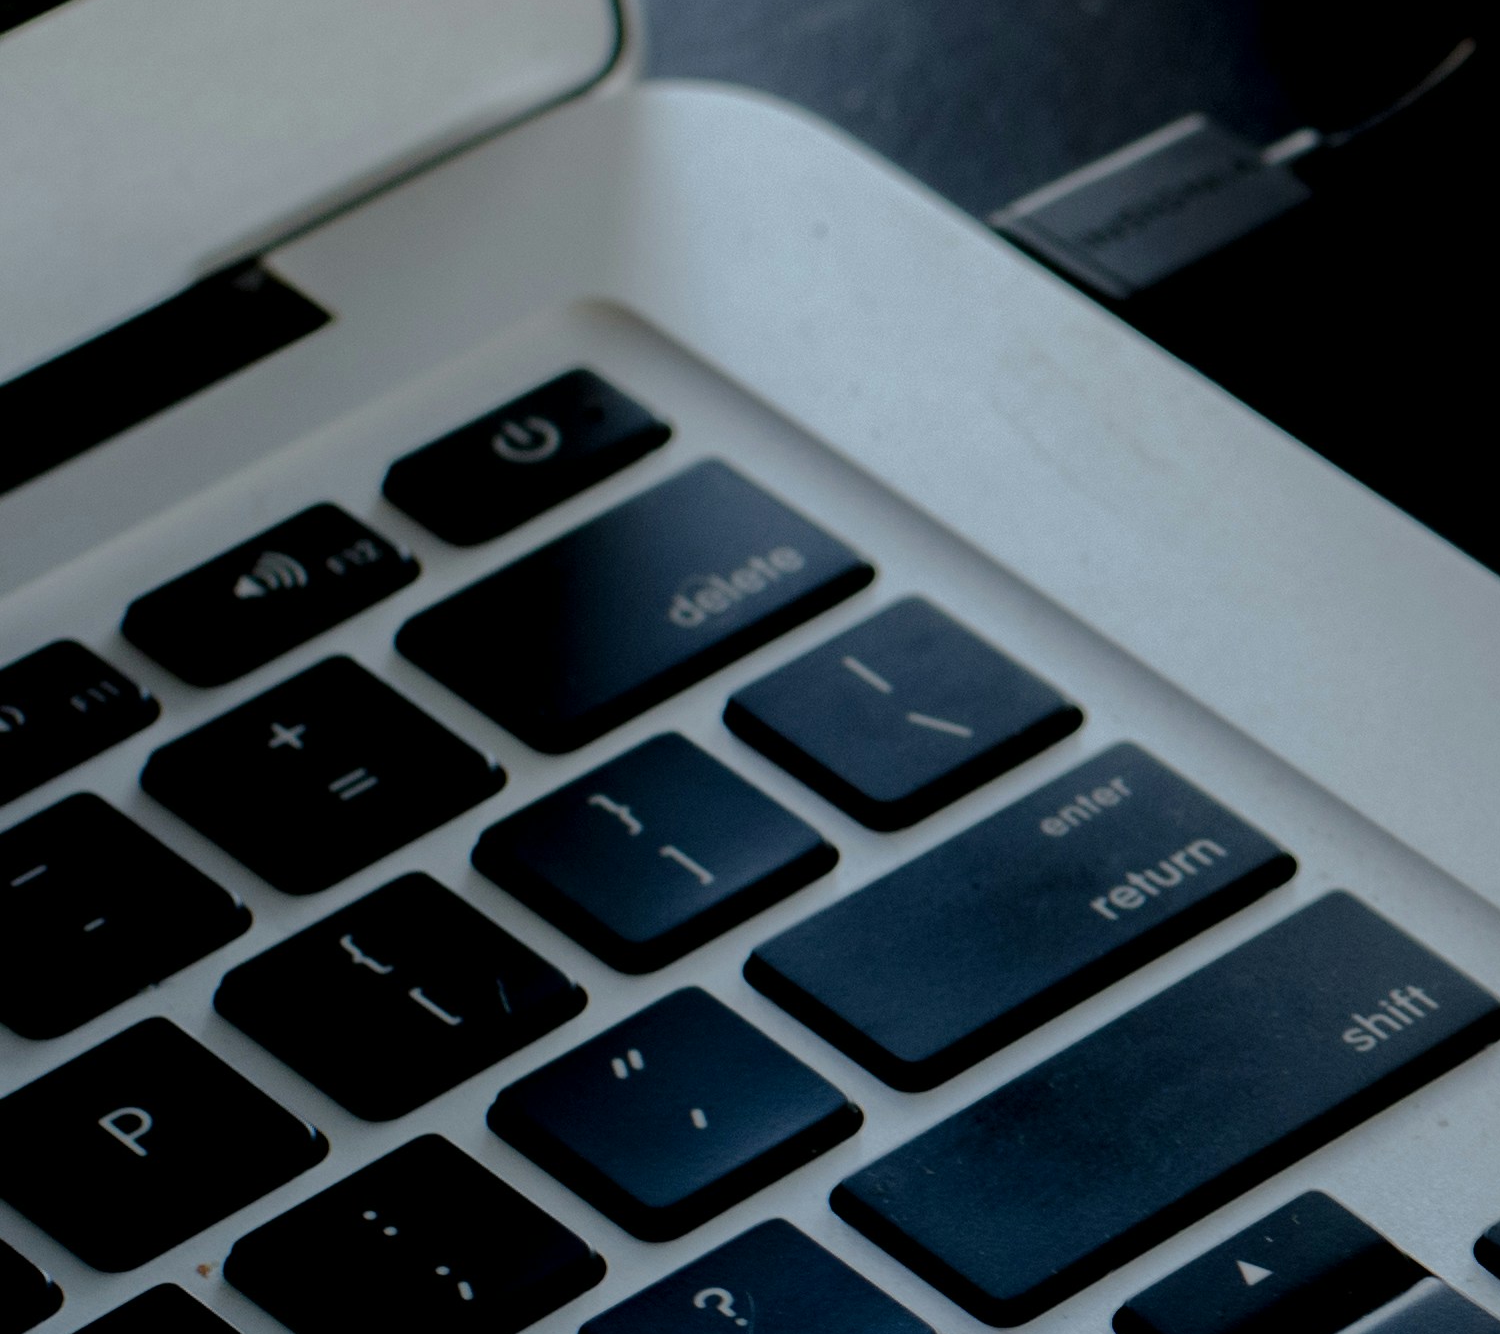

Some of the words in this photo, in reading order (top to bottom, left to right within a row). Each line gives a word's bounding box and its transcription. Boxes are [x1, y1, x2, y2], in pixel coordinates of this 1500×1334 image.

[668, 543, 804, 629] delete
[270, 724, 304, 748] +
[329, 768, 378, 800] =
[589, 794, 643, 836] }
[1040, 775, 1132, 839] enter
[661, 845, 717, 887] ]
[1090, 836, 1226, 923] return
[339, 934, 392, 975] {
[409, 987, 461, 1026] [
[1342, 985, 1439, 1052] shift
[98, 1106, 153, 1157] P
[693, 1287, 748, 1327] ?
